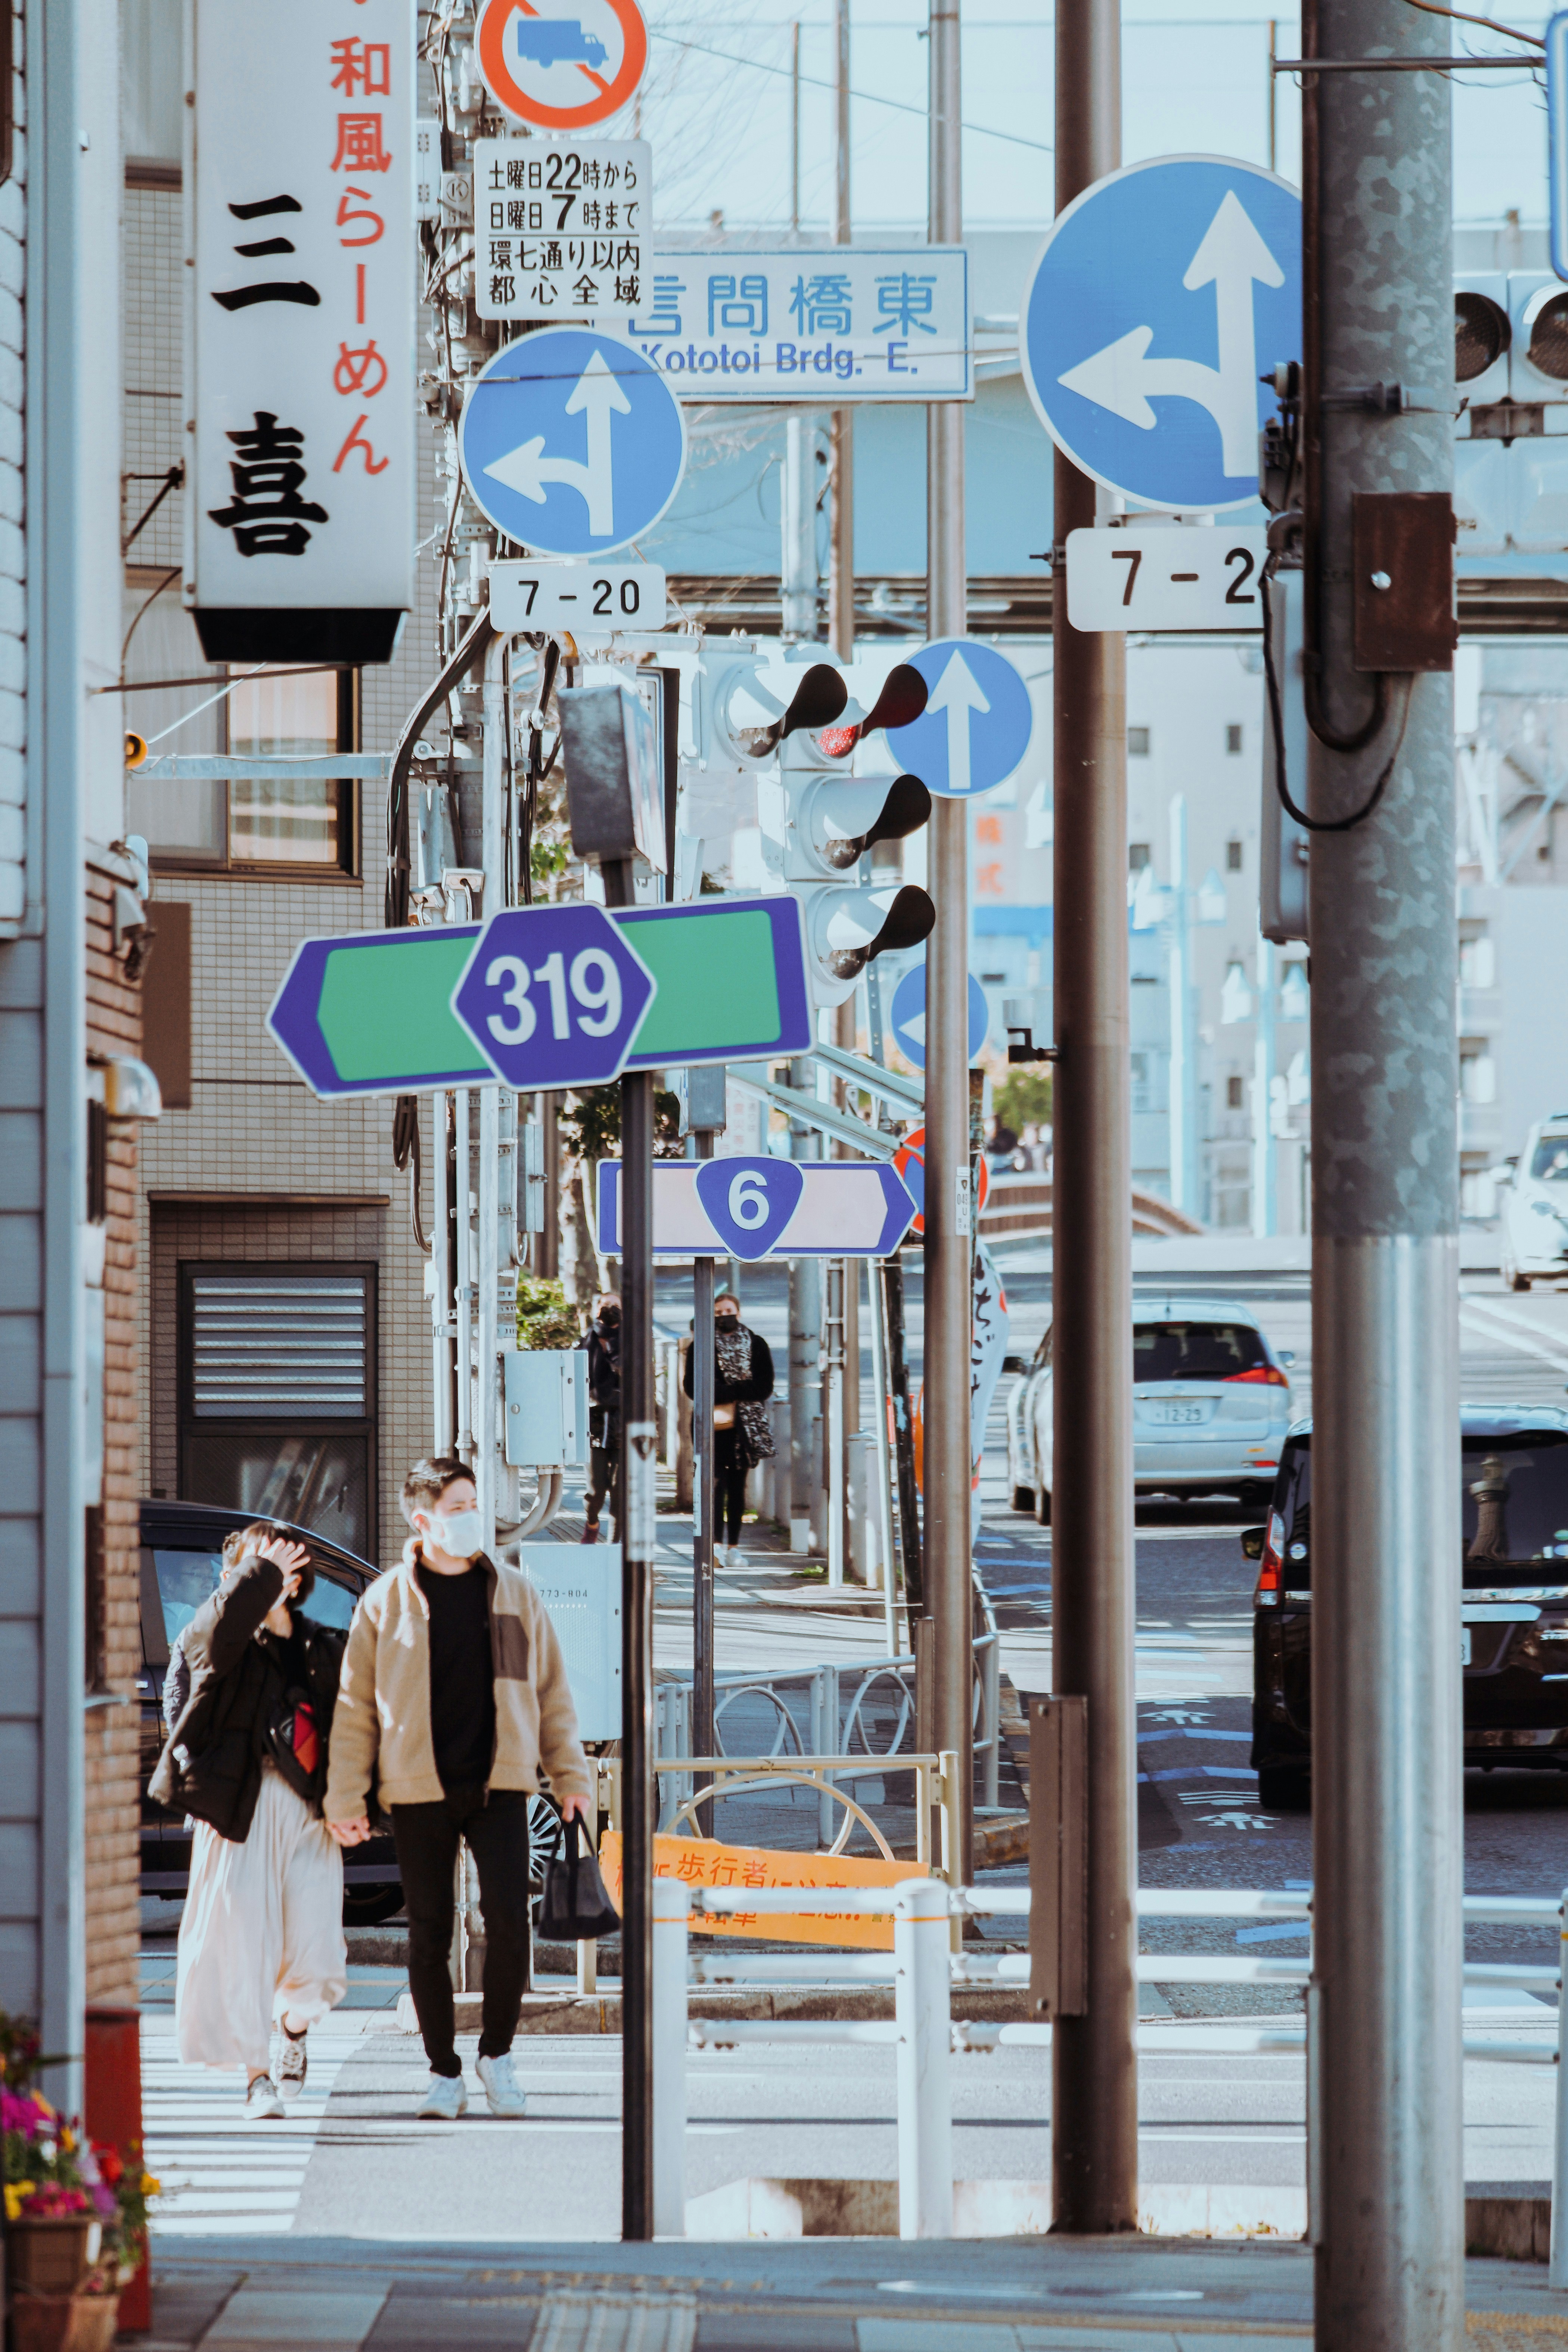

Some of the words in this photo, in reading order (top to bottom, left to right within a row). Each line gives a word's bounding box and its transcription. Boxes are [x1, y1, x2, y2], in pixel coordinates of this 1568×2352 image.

[488, 153, 637, 190] 土曜日22時から
[490, 194, 639, 231] 日曜日7時まで
[329, 36, 393, 475] 和風らーめん
[488, 240, 640, 272] 環七通り以内
[489, 274, 641, 306] 都心全域
[485, 948, 622, 1046] 319
[728, 1170, 770, 1230] 6
